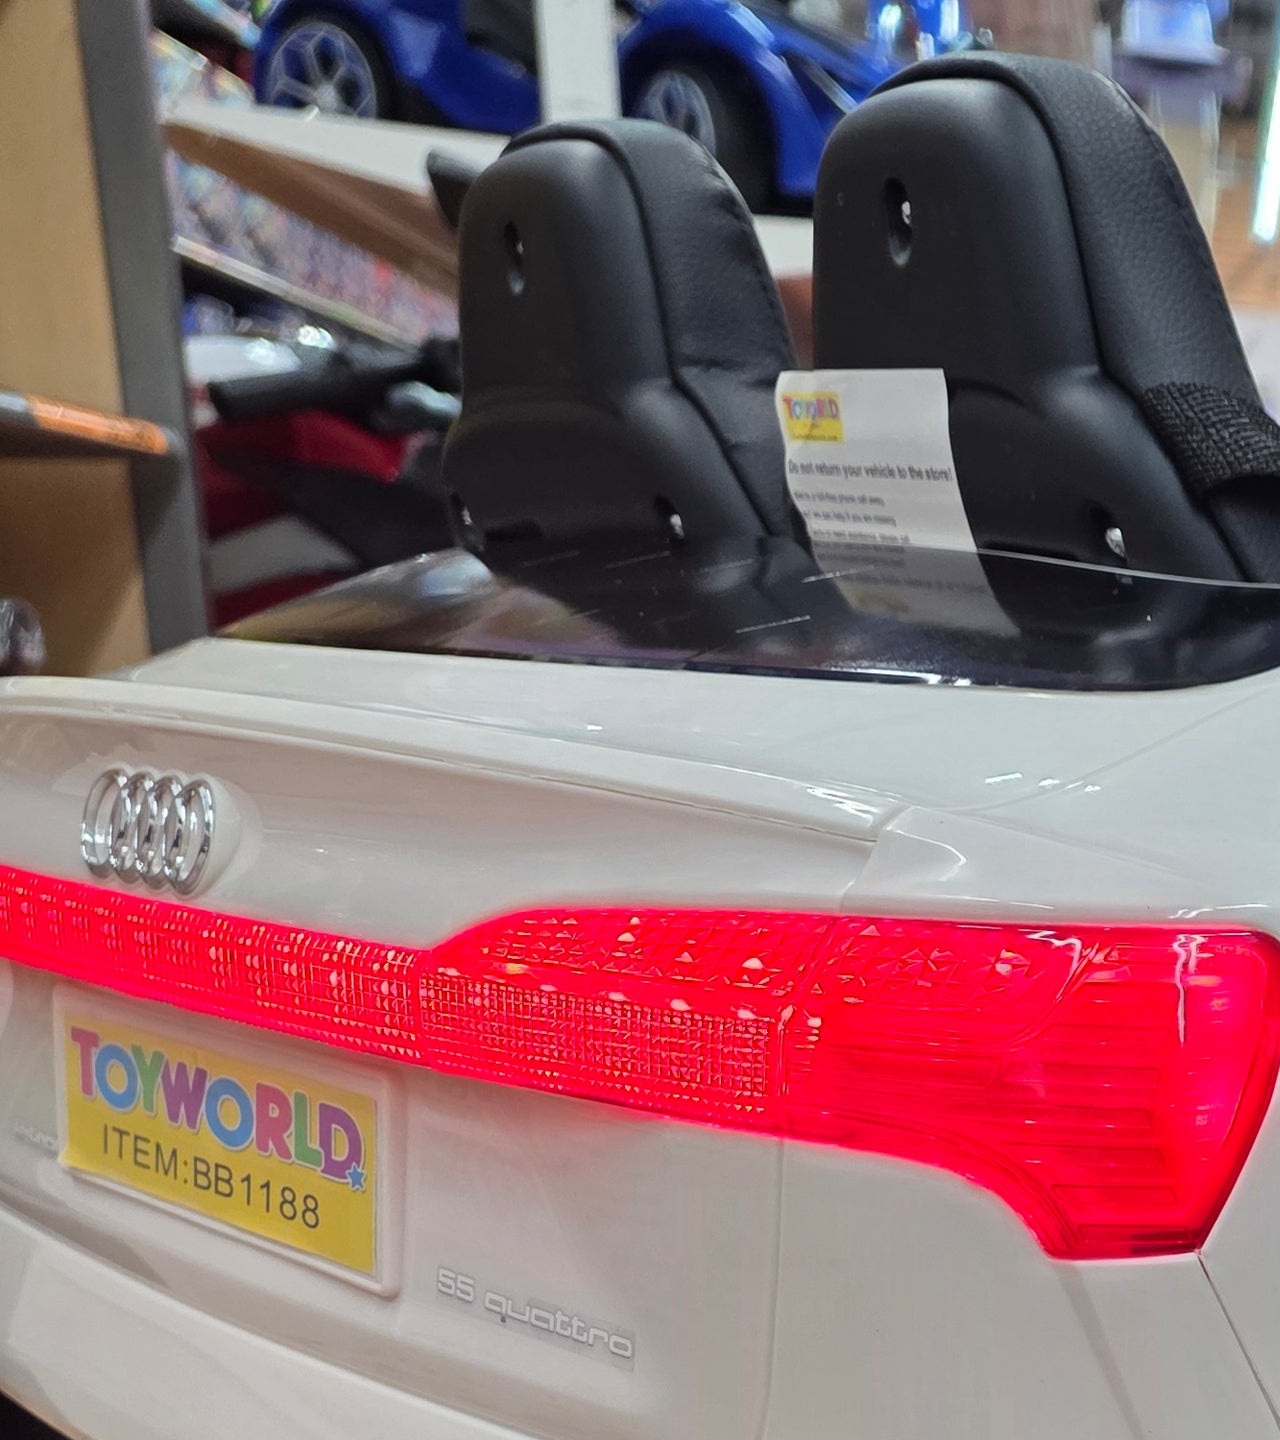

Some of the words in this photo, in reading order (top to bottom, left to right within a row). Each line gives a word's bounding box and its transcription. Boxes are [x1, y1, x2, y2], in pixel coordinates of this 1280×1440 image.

[71, 1026, 363, 1182] TOYWORLD
[103, 1123, 320, 1230] ITEM:BB1188
[436, 1266, 475, 1304] 55
[483, 1289, 634, 1359] quattro
